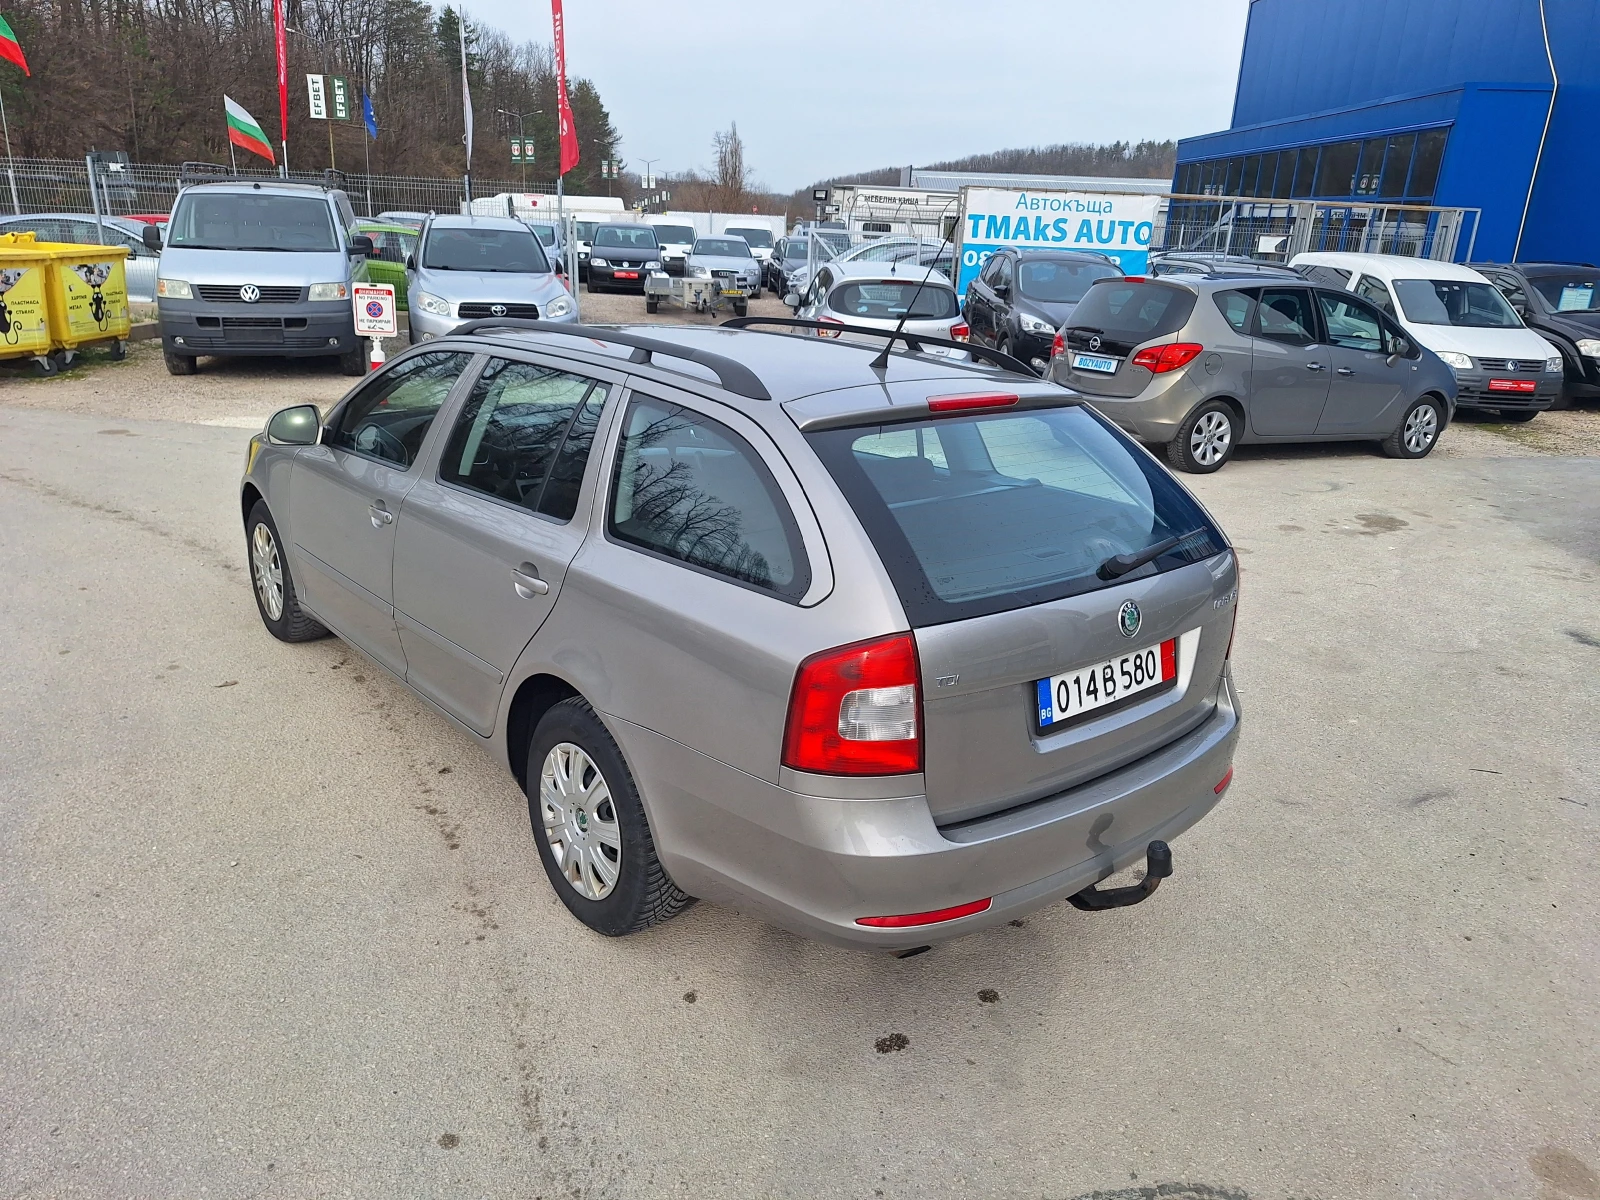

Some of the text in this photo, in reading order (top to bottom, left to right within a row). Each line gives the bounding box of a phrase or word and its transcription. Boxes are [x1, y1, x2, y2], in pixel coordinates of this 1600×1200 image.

[311, 78, 322, 115] EFBET
[334, 78, 346, 117] EFBET
[1016, 193, 1113, 216] Автокъща
[967, 214, 1153, 246] TMAkS AUTO
[1078, 357, 1112, 370] BOZYAUTO
[1040, 707, 1052, 720] BG
